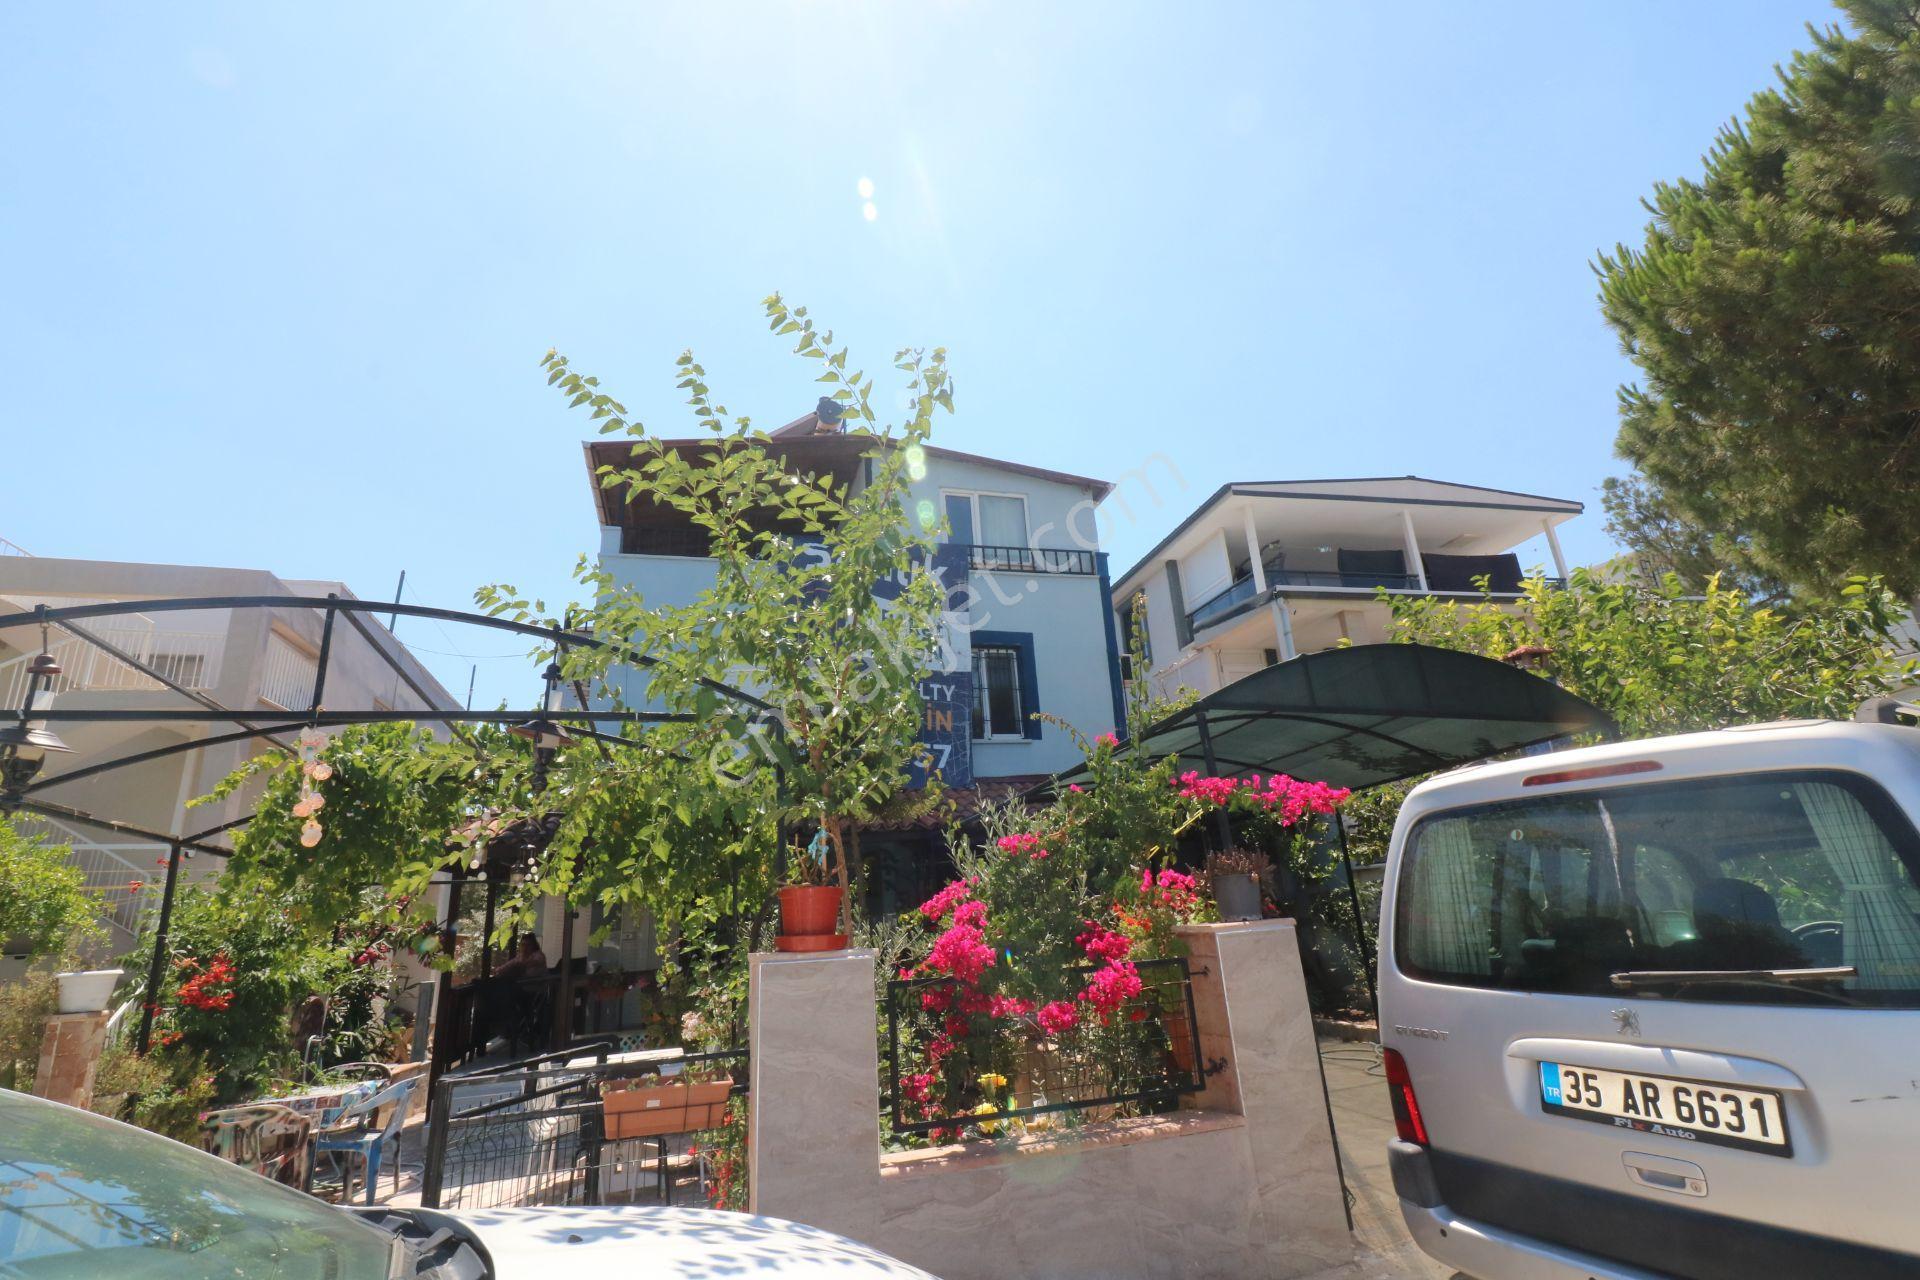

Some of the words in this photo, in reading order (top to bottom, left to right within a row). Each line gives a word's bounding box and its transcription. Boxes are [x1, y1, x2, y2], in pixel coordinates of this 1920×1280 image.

[915, 682, 956, 702] LTY
[1547, 1086, 1561, 1098] TR
[1564, 1070, 1602, 1108] 35
[1623, 1079, 1663, 1119] AR
[1673, 1086, 1770, 1138] 6631
[1651, 1124, 1696, 1140] Auto
